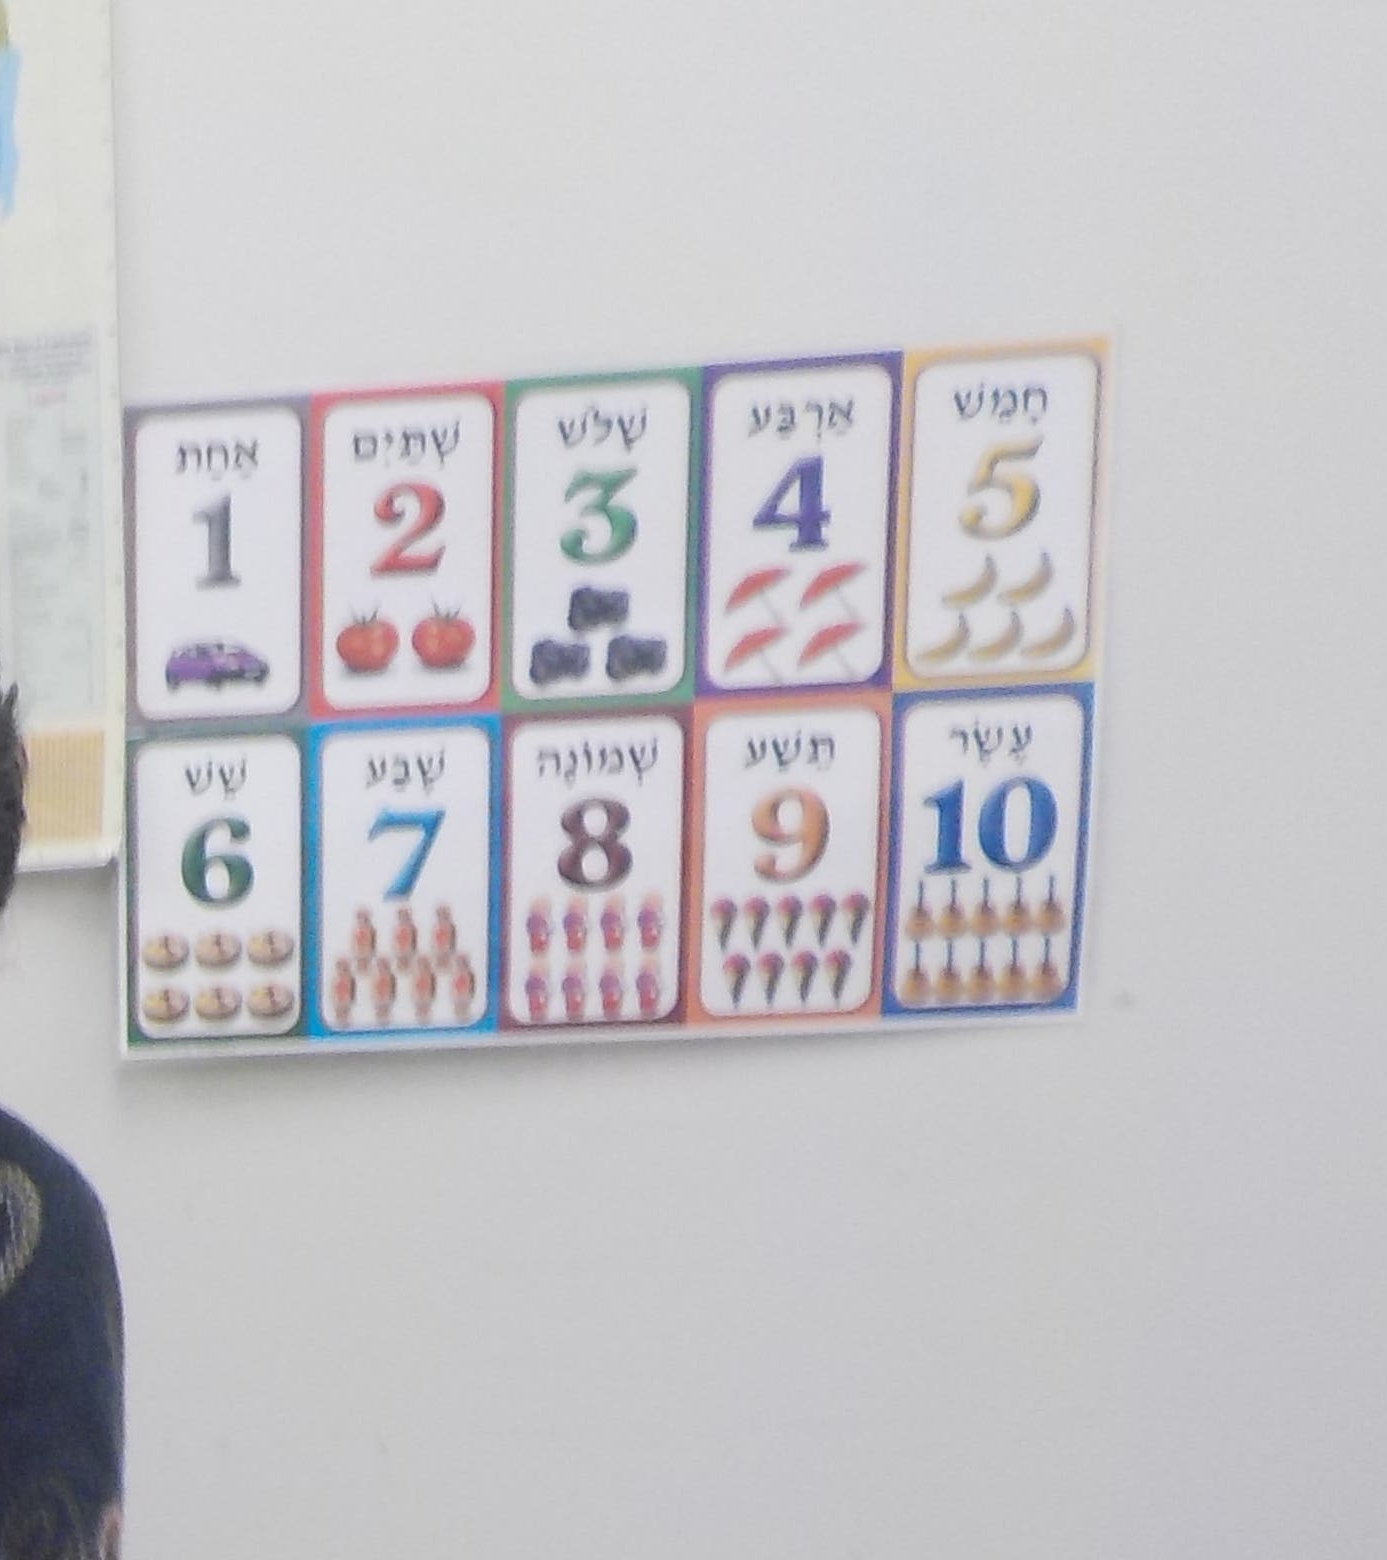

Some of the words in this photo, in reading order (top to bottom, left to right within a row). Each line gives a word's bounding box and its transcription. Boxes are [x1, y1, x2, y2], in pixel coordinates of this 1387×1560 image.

[369, 480, 449, 582] 2
[558, 467, 641, 569] 3
[751, 453, 833, 556] 4
[958, 438, 1045, 542] 5
[192, 492, 244, 592] 1
[179, 815, 257, 912] 6
[365, 806, 449, 904] 7
[556, 796, 636, 896] 8
[750, 788, 834, 888] 9
[921, 775, 1061, 876] 10
